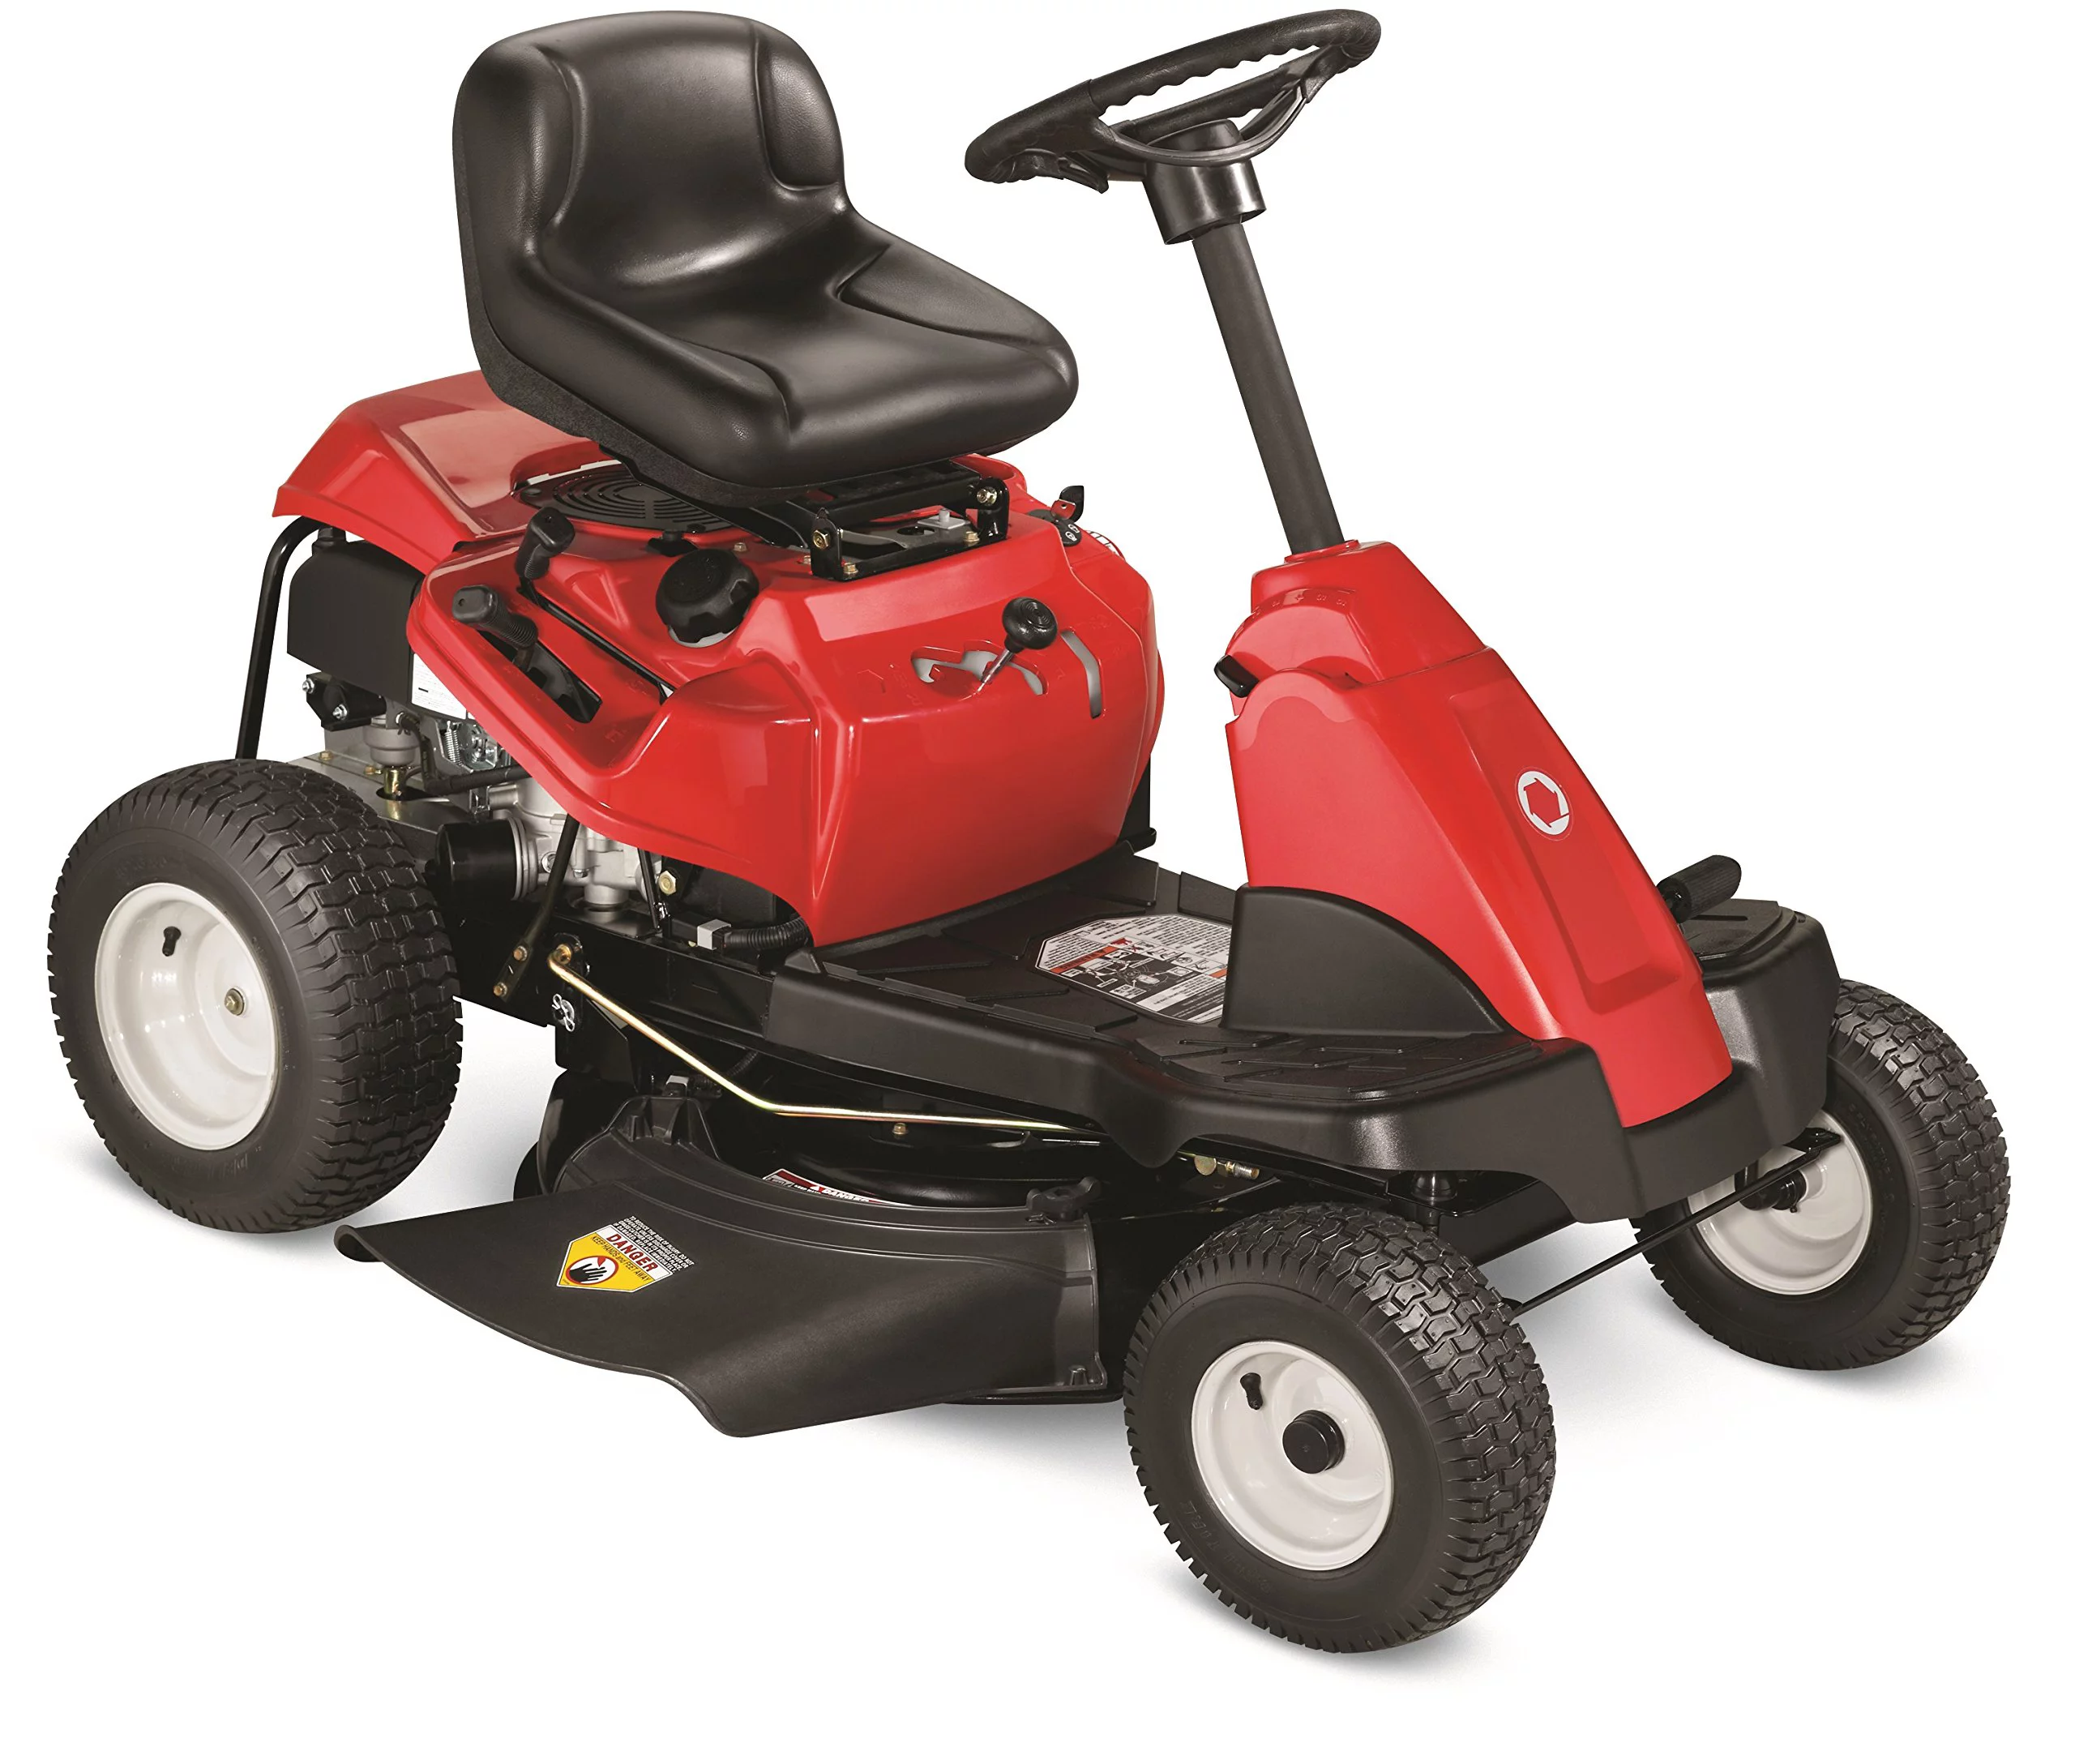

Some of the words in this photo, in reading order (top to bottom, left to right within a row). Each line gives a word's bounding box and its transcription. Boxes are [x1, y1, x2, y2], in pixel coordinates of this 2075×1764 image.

[591, 1235, 607, 1246] KEEP
[601, 1243, 621, 1257] HANDS
[614, 1255, 627, 1263] and
[622, 1261, 639, 1271] FEET
[634, 1269, 652, 1282] AWAY
[605, 1233, 659, 1272] DANGER
